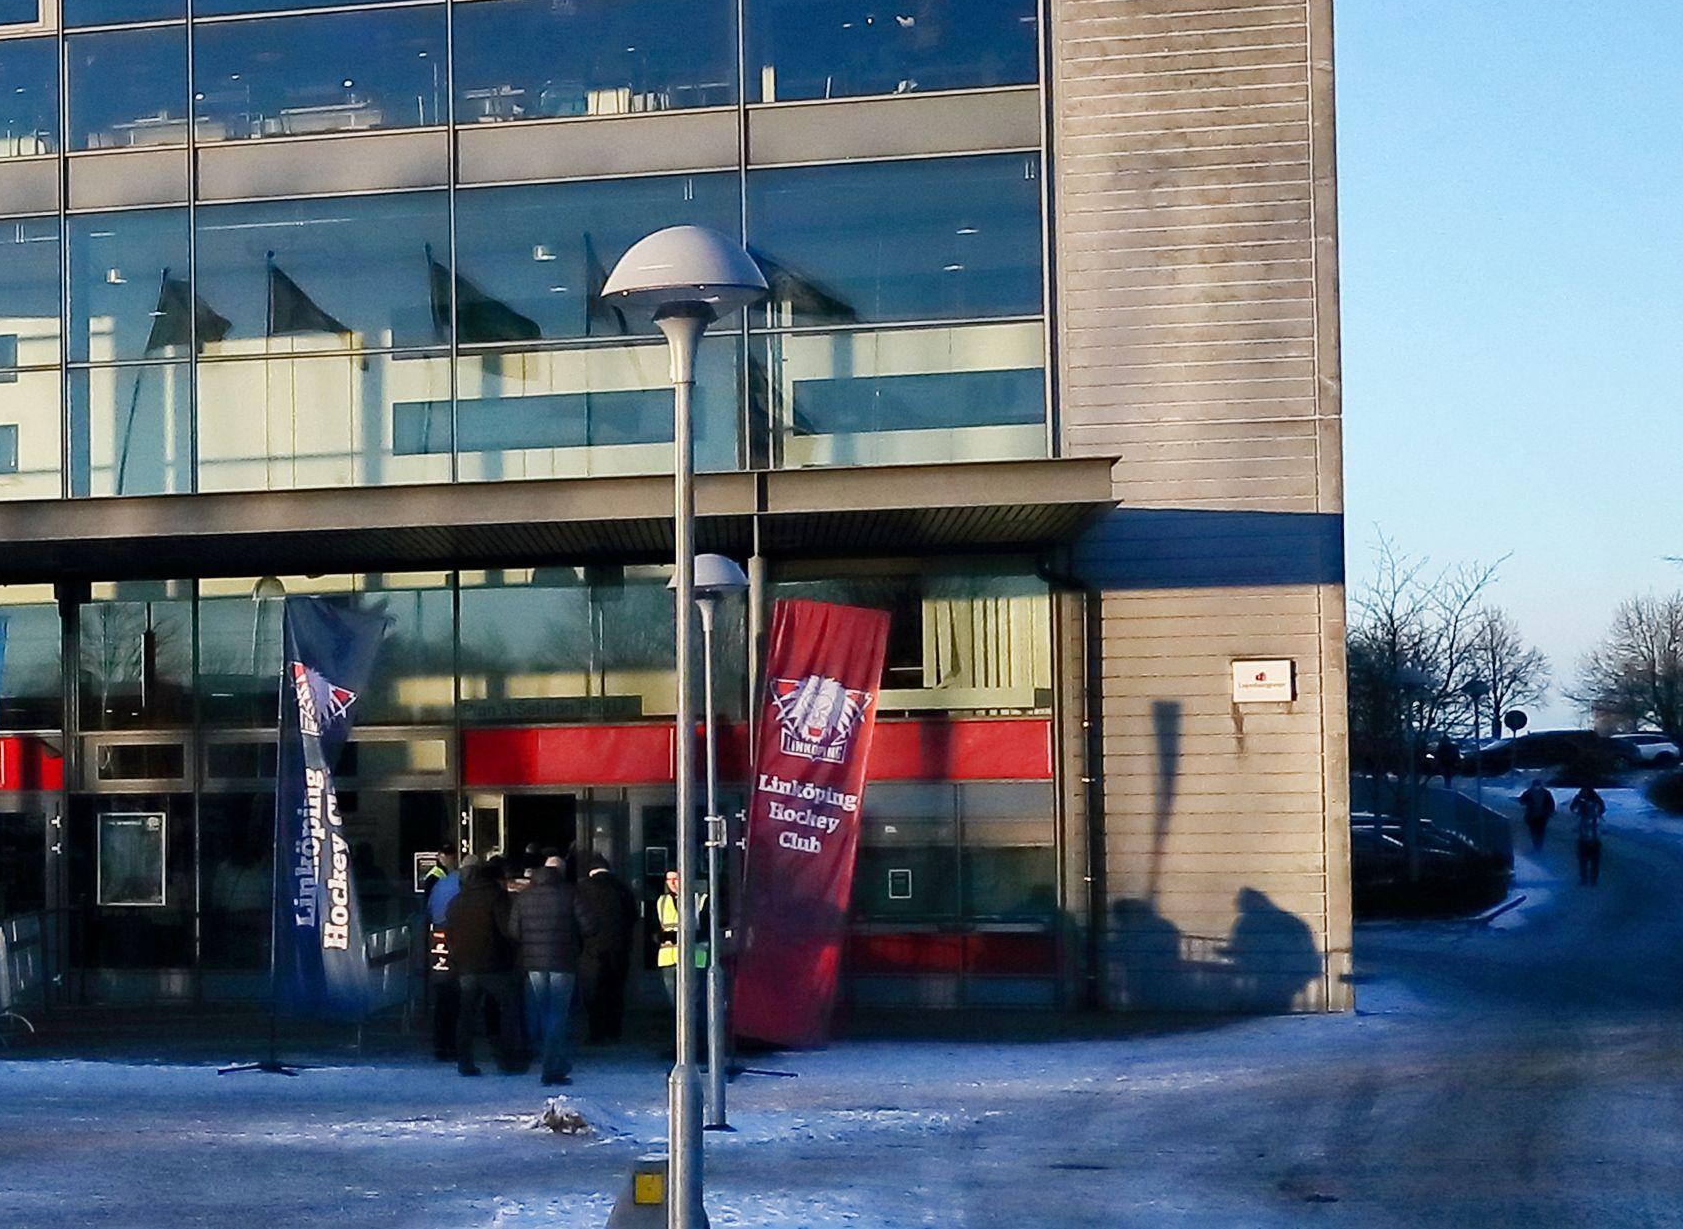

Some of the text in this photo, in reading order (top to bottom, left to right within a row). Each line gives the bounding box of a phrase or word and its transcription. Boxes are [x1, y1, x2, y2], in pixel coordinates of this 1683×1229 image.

[758, 773, 859, 812] Linköping
[769, 801, 841, 834] Hockey
[295, 767, 326, 928] Linköping
[778, 831, 822, 854] Club
[323, 832, 350, 951] Hockey
